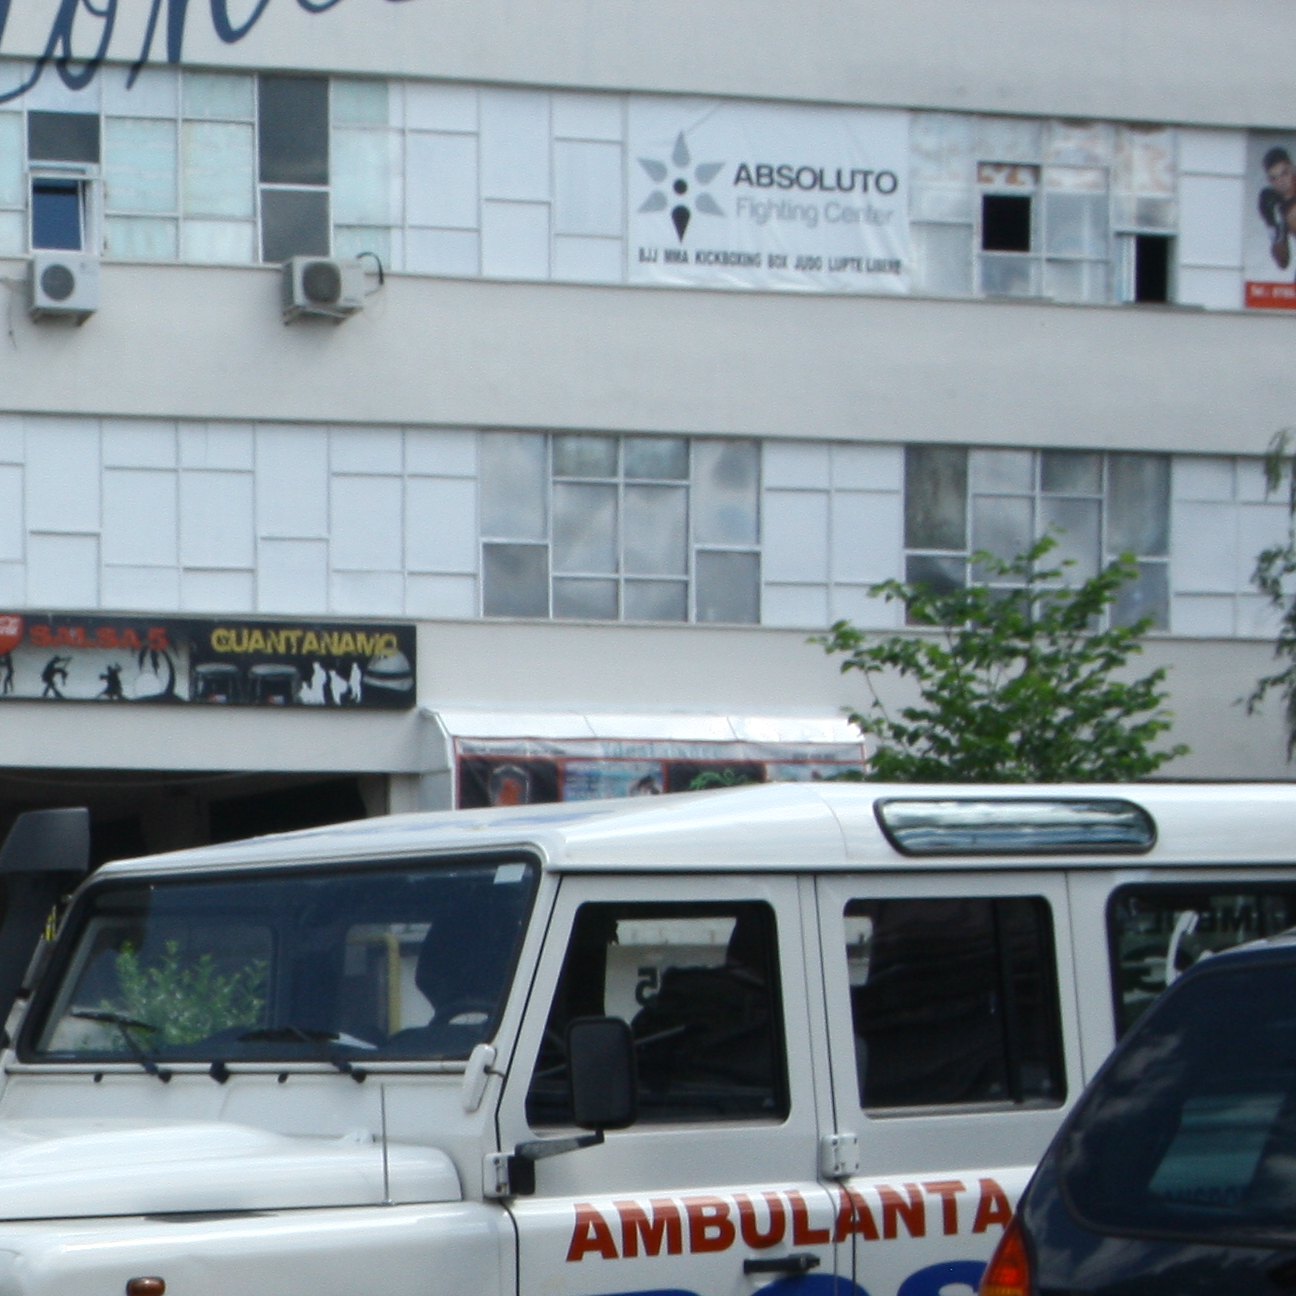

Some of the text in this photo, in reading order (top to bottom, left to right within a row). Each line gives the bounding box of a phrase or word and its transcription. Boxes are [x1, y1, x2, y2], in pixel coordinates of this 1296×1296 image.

[734, 163, 898, 195] ABSOLUTO
[735, 197, 895, 228] Fighting Center
[29, 624, 142, 651] SALSA
[210, 626, 398, 657] GUANTANAMO
[565, 1178, 1017, 1262] AMBULANTA
